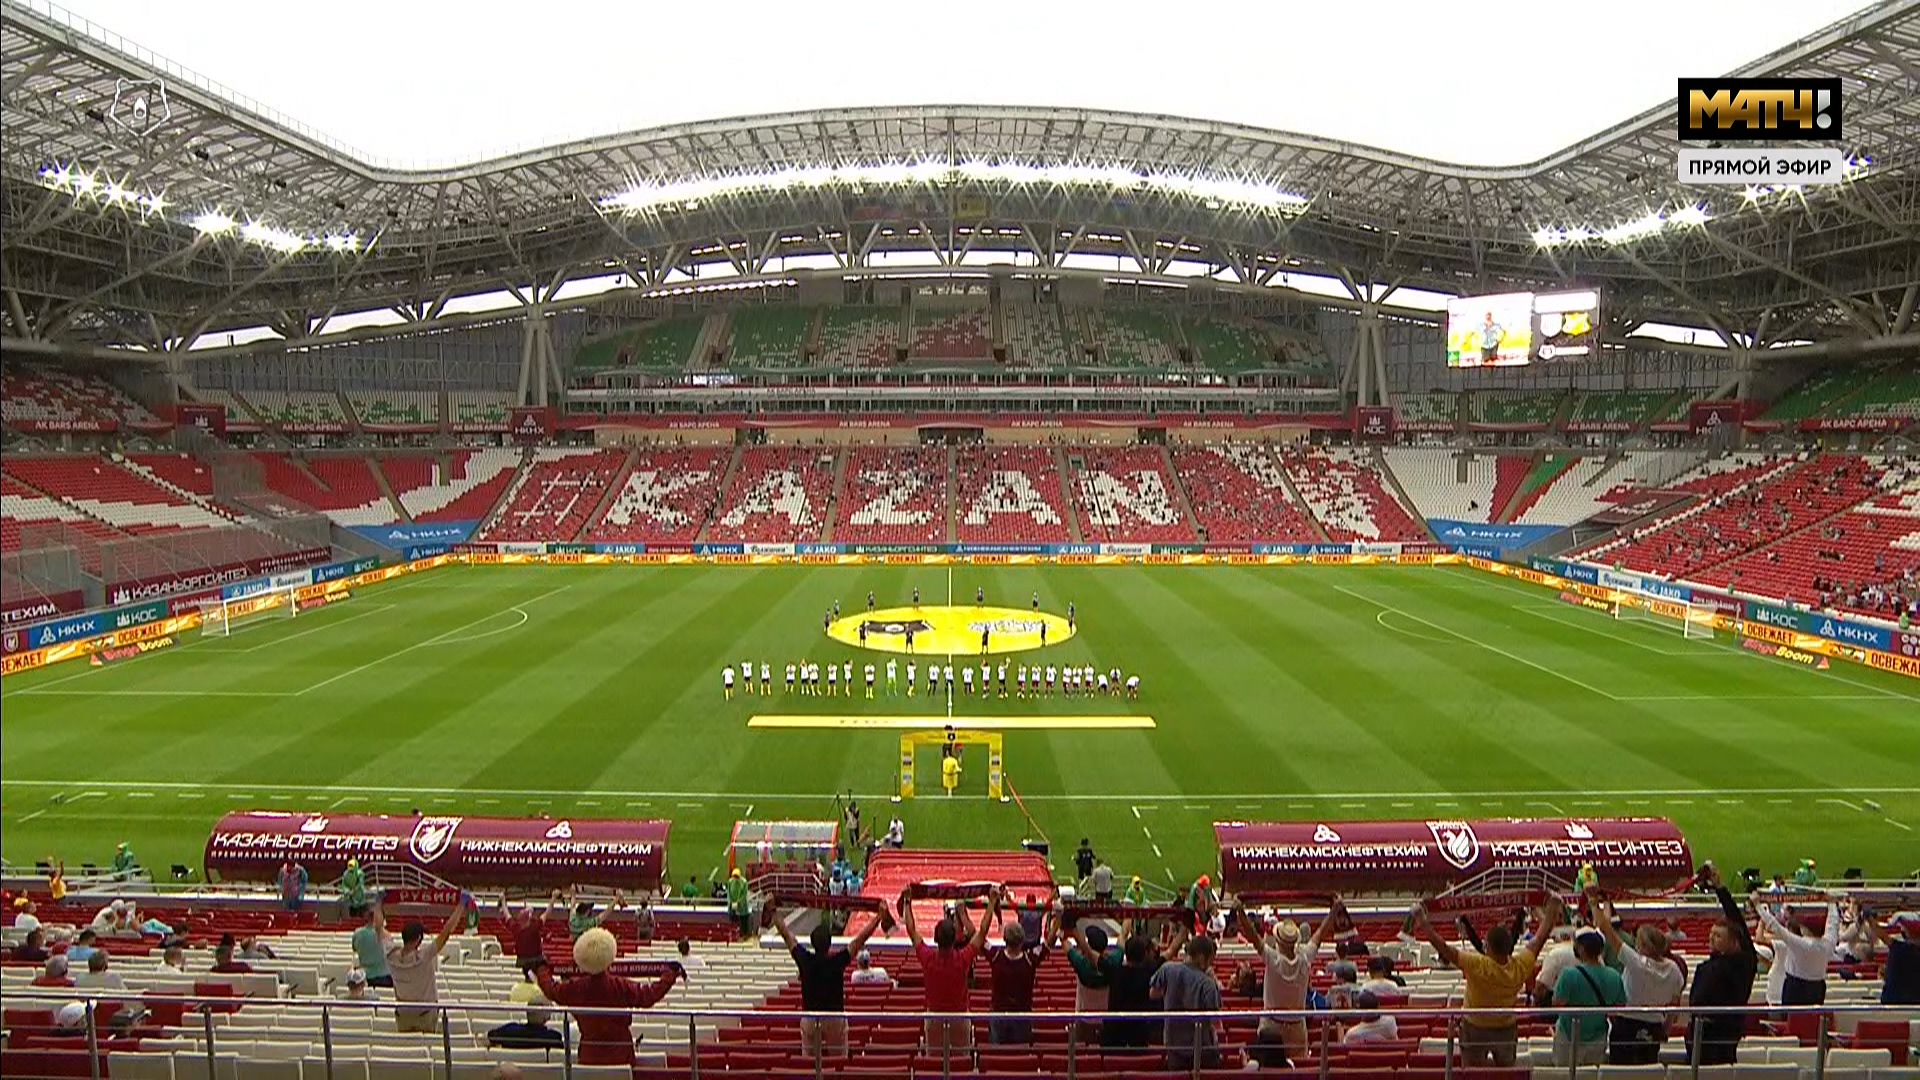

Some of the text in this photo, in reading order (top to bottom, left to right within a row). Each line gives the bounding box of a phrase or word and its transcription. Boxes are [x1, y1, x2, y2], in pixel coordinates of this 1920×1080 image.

[35, 421, 99, 430] AK BARS ARENA
[1820, 418, 1887, 428] АК БАРС АРЕНА
[515, 426, 544, 434] НКНХ
[1363, 425, 1386, 435] КОС
[615, 546, 636, 554] JAKO
[816, 546, 837, 554] JAKO
[1070, 546, 1092, 554] JAKO
[1272, 546, 1293, 554] JAKO
[132, 568, 248, 601] КАЗАНЬОРГСИНТЕЗ
[1660, 586, 1681, 599] JAKO
[3, 604, 56, 623] ТЕХИМ
[131, 608, 156, 626] КОС
[1771, 612, 1798, 629] КОС
[58, 621, 96, 640] НКНХ
[117, 625, 162, 646] ОСВЕЖАЕТ
[1747, 622, 1792, 646] ОСВЕЖАЕТ
[1838, 626, 1878, 644] НКНХ
[137, 638, 173, 652] Boom
[1775, 646, 1814, 666] Boom
[1871, 652, 1920, 675] ОСВЕЖА
[213, 833, 398, 851] КАЗАНЬОРГСИНТЕЗ
[460, 841, 651, 855] НИЖНЕКАМСКНЕФТЕХИМ
[1490, 840, 1683, 857] КАЗАНЬОРГСИНТЕЗ
[211, 850, 284, 860] ПРЕМИАЛЬНЫЙ
[288, 852, 332, 861] СПОНСОР
[335, 853, 347, 861] ФК
[1232, 845, 1428, 858] НИЖНЕКАМСКНЕФТЕХИМ
[463, 856, 533, 865] ГЕНЕРАЛЬНЫЙ
[536, 857, 581, 866] СПОНСОР
[584, 858, 597, 866] ФК
[1238, 862, 1311, 871] ГЕНЕРАЛЬНЫЙ
[1315, 861, 1360, 870] СПОНСОР
[1494, 860, 1571, 869] ПРЕМИАЛЬНЫЙ
[1624, 859, 1638, 867] ФК
[399, 891, 457, 902] РУБИН
